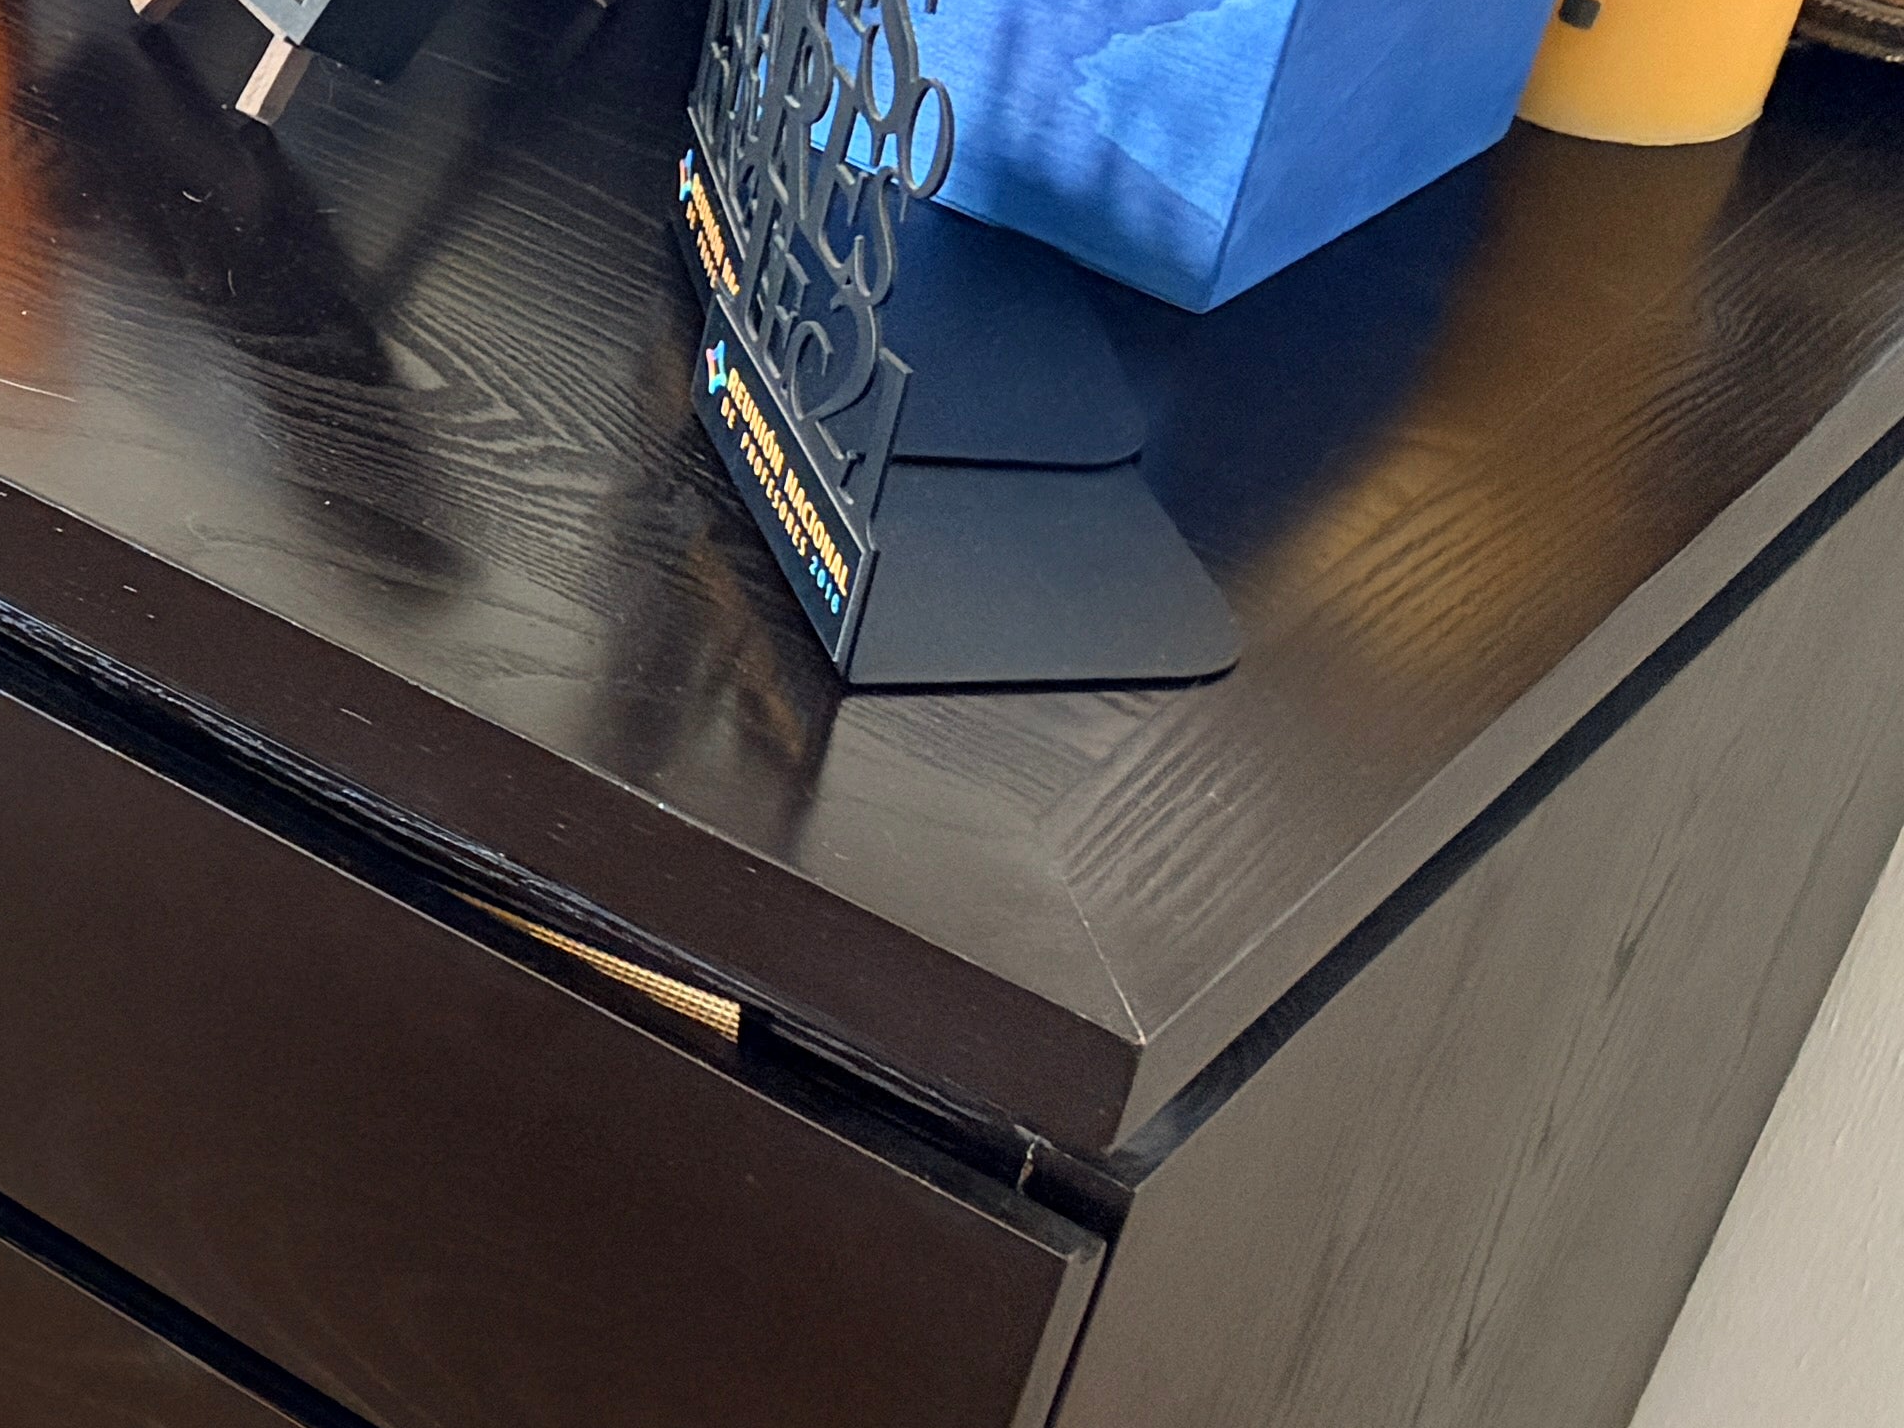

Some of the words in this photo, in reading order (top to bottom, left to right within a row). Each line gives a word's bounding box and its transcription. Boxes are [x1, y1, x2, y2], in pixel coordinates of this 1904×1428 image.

[720, 396, 738, 430] DE
[740, 431, 809, 557] PROFESORES
[727, 367, 785, 478] REUNIÓN
[783, 468, 849, 597] NACIONAL
